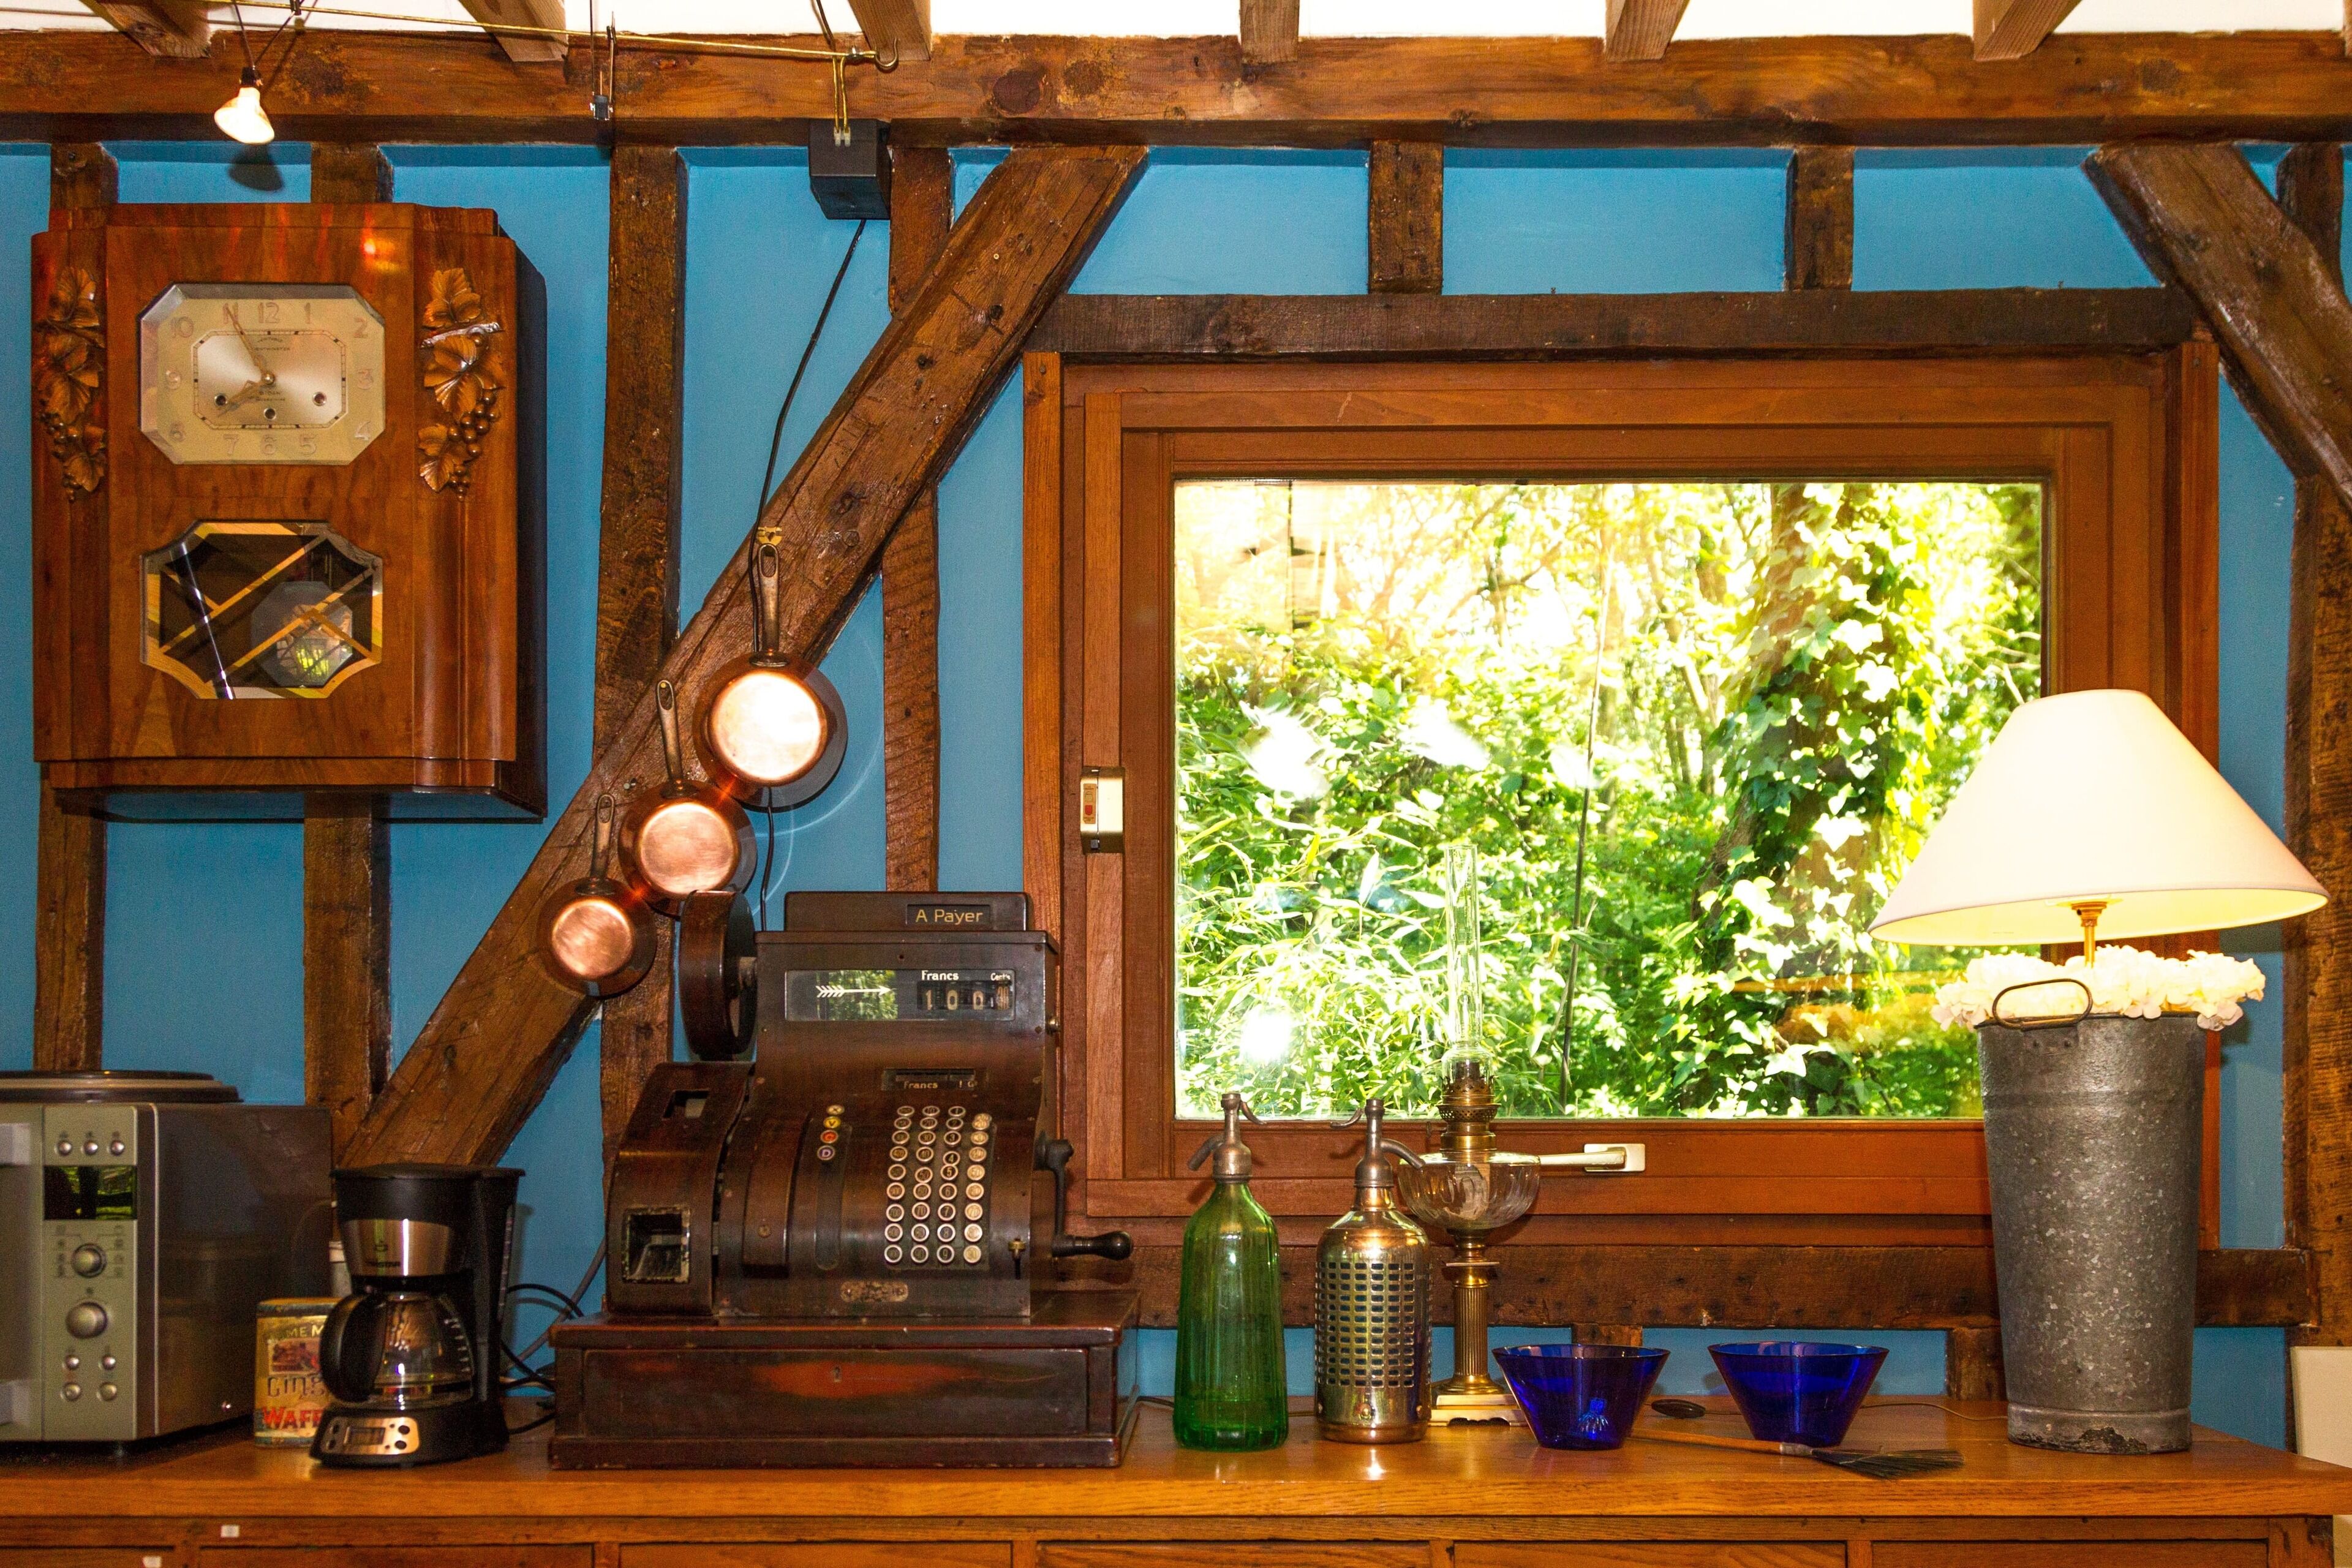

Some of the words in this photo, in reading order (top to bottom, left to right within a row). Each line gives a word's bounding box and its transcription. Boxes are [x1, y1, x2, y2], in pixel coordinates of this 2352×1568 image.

[257, 302, 280, 324] 12
[304, 303, 311, 324] 1
[170, 316, 194, 338] 10
[354, 317, 368, 338] 2
[165, 370, 181, 390] 9
[357, 369, 374, 390] 3
[354, 421, 371, 441] 4
[223, 434, 239, 455] 7
[262, 434, 276, 455] 6
[300, 434, 317, 455] 5
[916, 909, 927, 922] A
[934, 909, 983, 925] Payer
[921, 970, 959, 981] Francs
